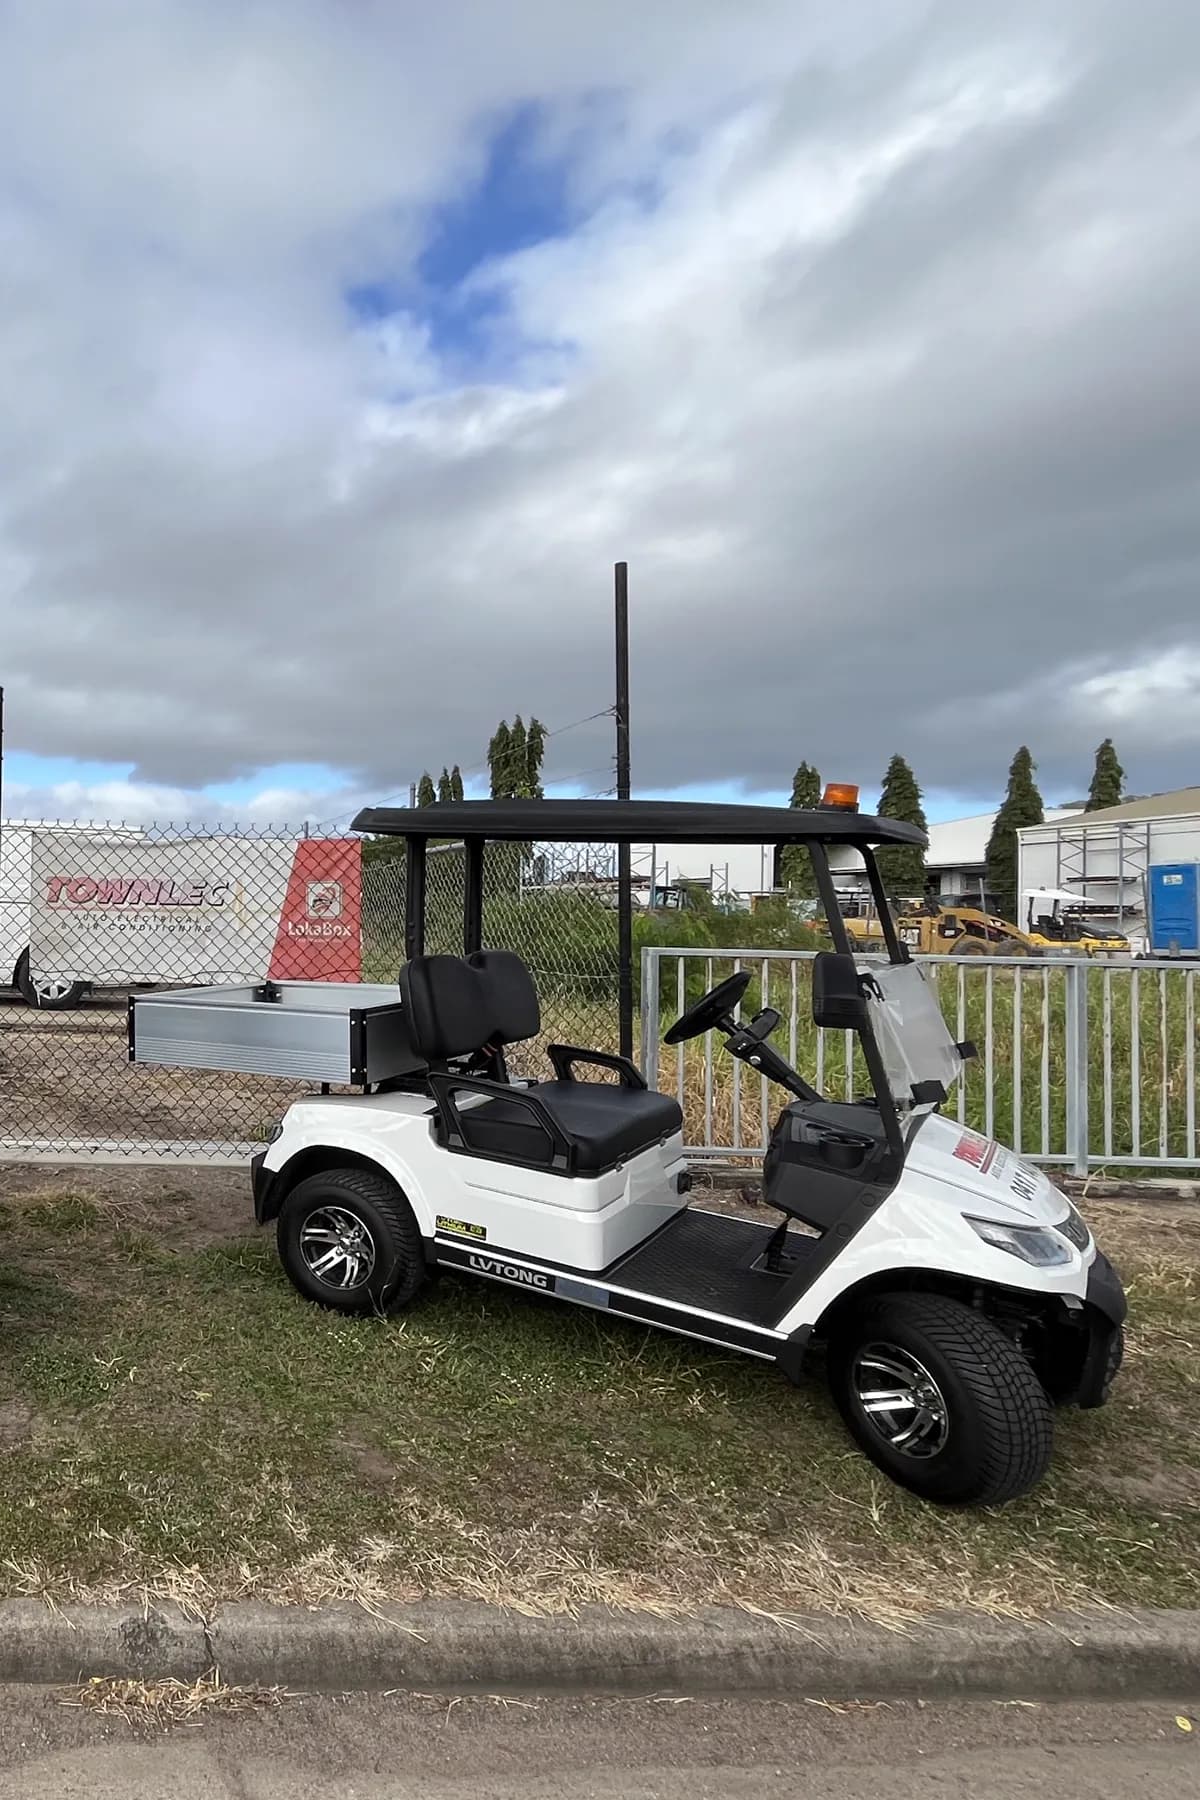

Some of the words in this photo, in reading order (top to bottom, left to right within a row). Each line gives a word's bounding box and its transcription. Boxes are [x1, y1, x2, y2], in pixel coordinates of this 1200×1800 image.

[47, 877, 230, 906] TOWNLEC
[288, 921, 352, 937] LokaBox
[469, 1255, 548, 1288] LVTONG
